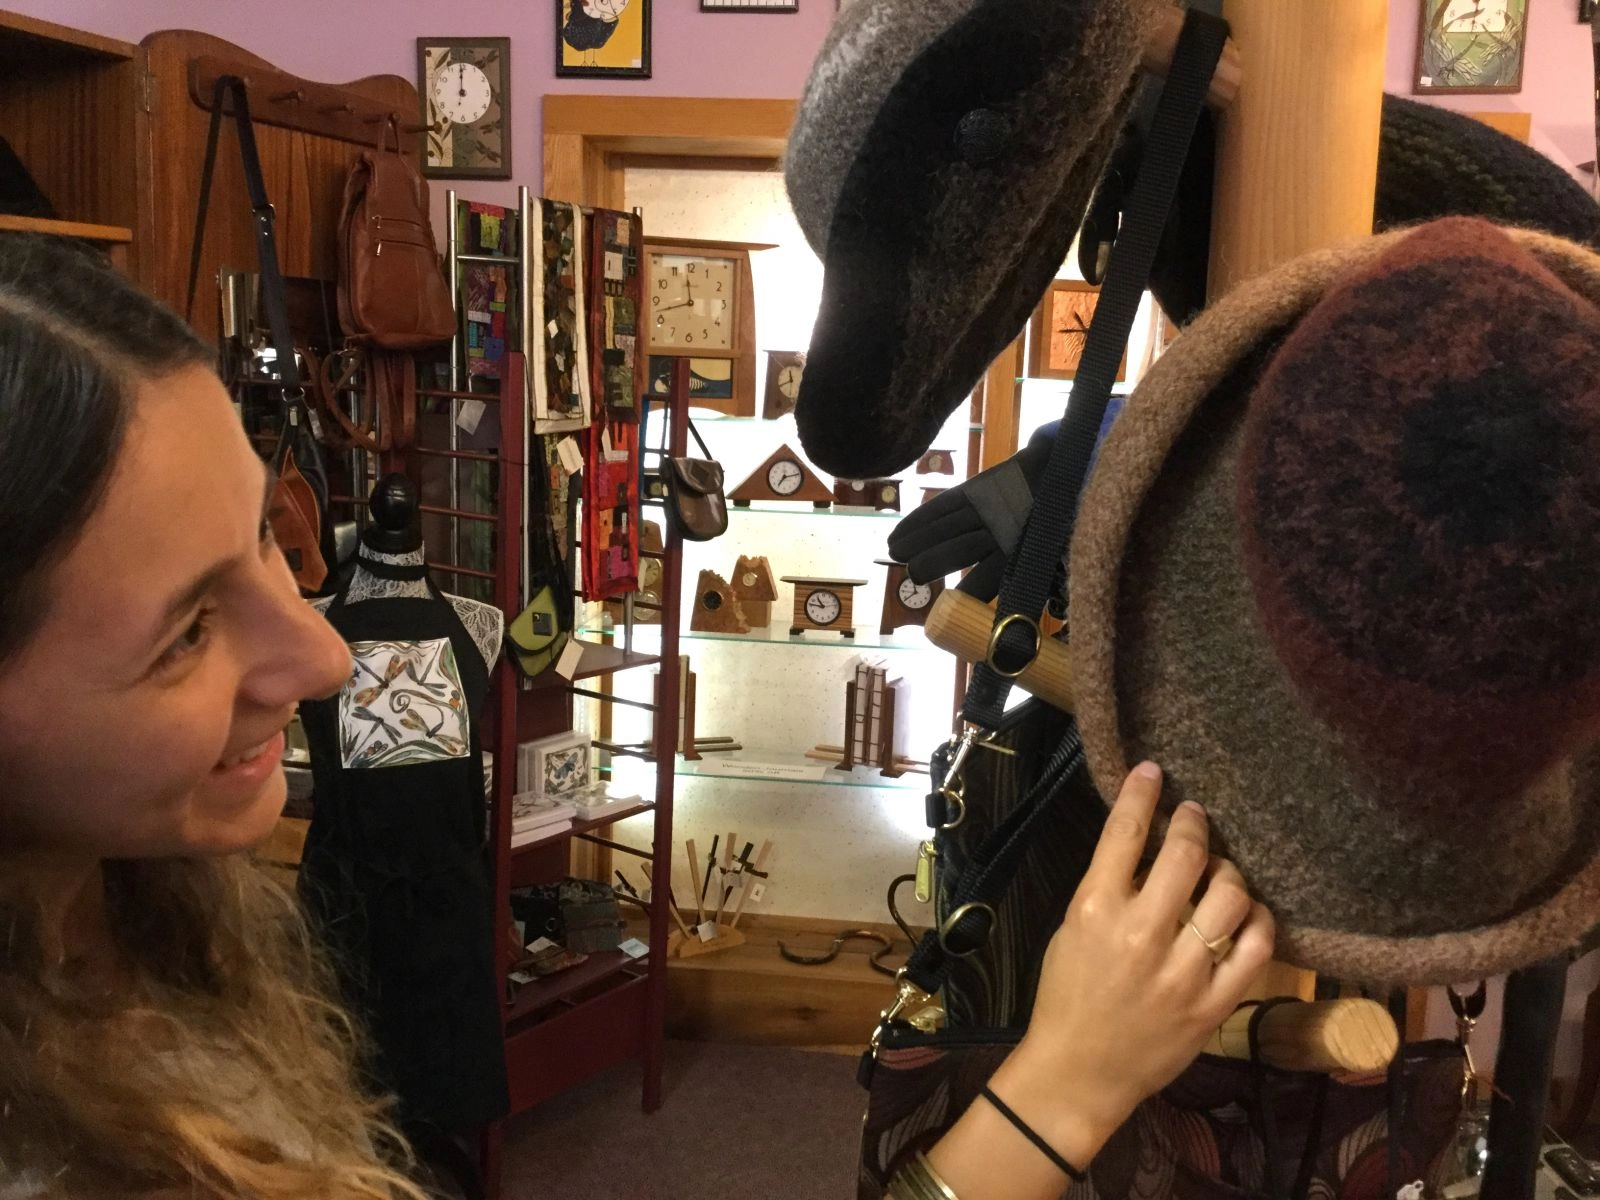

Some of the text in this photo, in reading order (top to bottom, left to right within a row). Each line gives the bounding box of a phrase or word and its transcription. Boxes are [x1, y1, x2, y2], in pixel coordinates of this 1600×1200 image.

[485, 89, 490, 97] 3
[474, 111, 478, 119] 5
[672, 266, 678, 277] 11
[687, 262, 696, 274] 12
[705, 268, 709, 279] 1
[658, 279, 668, 290] 10
[716, 281, 722, 292] 2
[652, 296, 660, 306] 9
[722, 300, 726, 310] 3
[657, 314, 665, 324] 8
[714, 317, 721, 327] 4
[670, 326, 676, 337] 7
[702, 328, 708, 340] 5
[685, 332, 693, 343] 6
